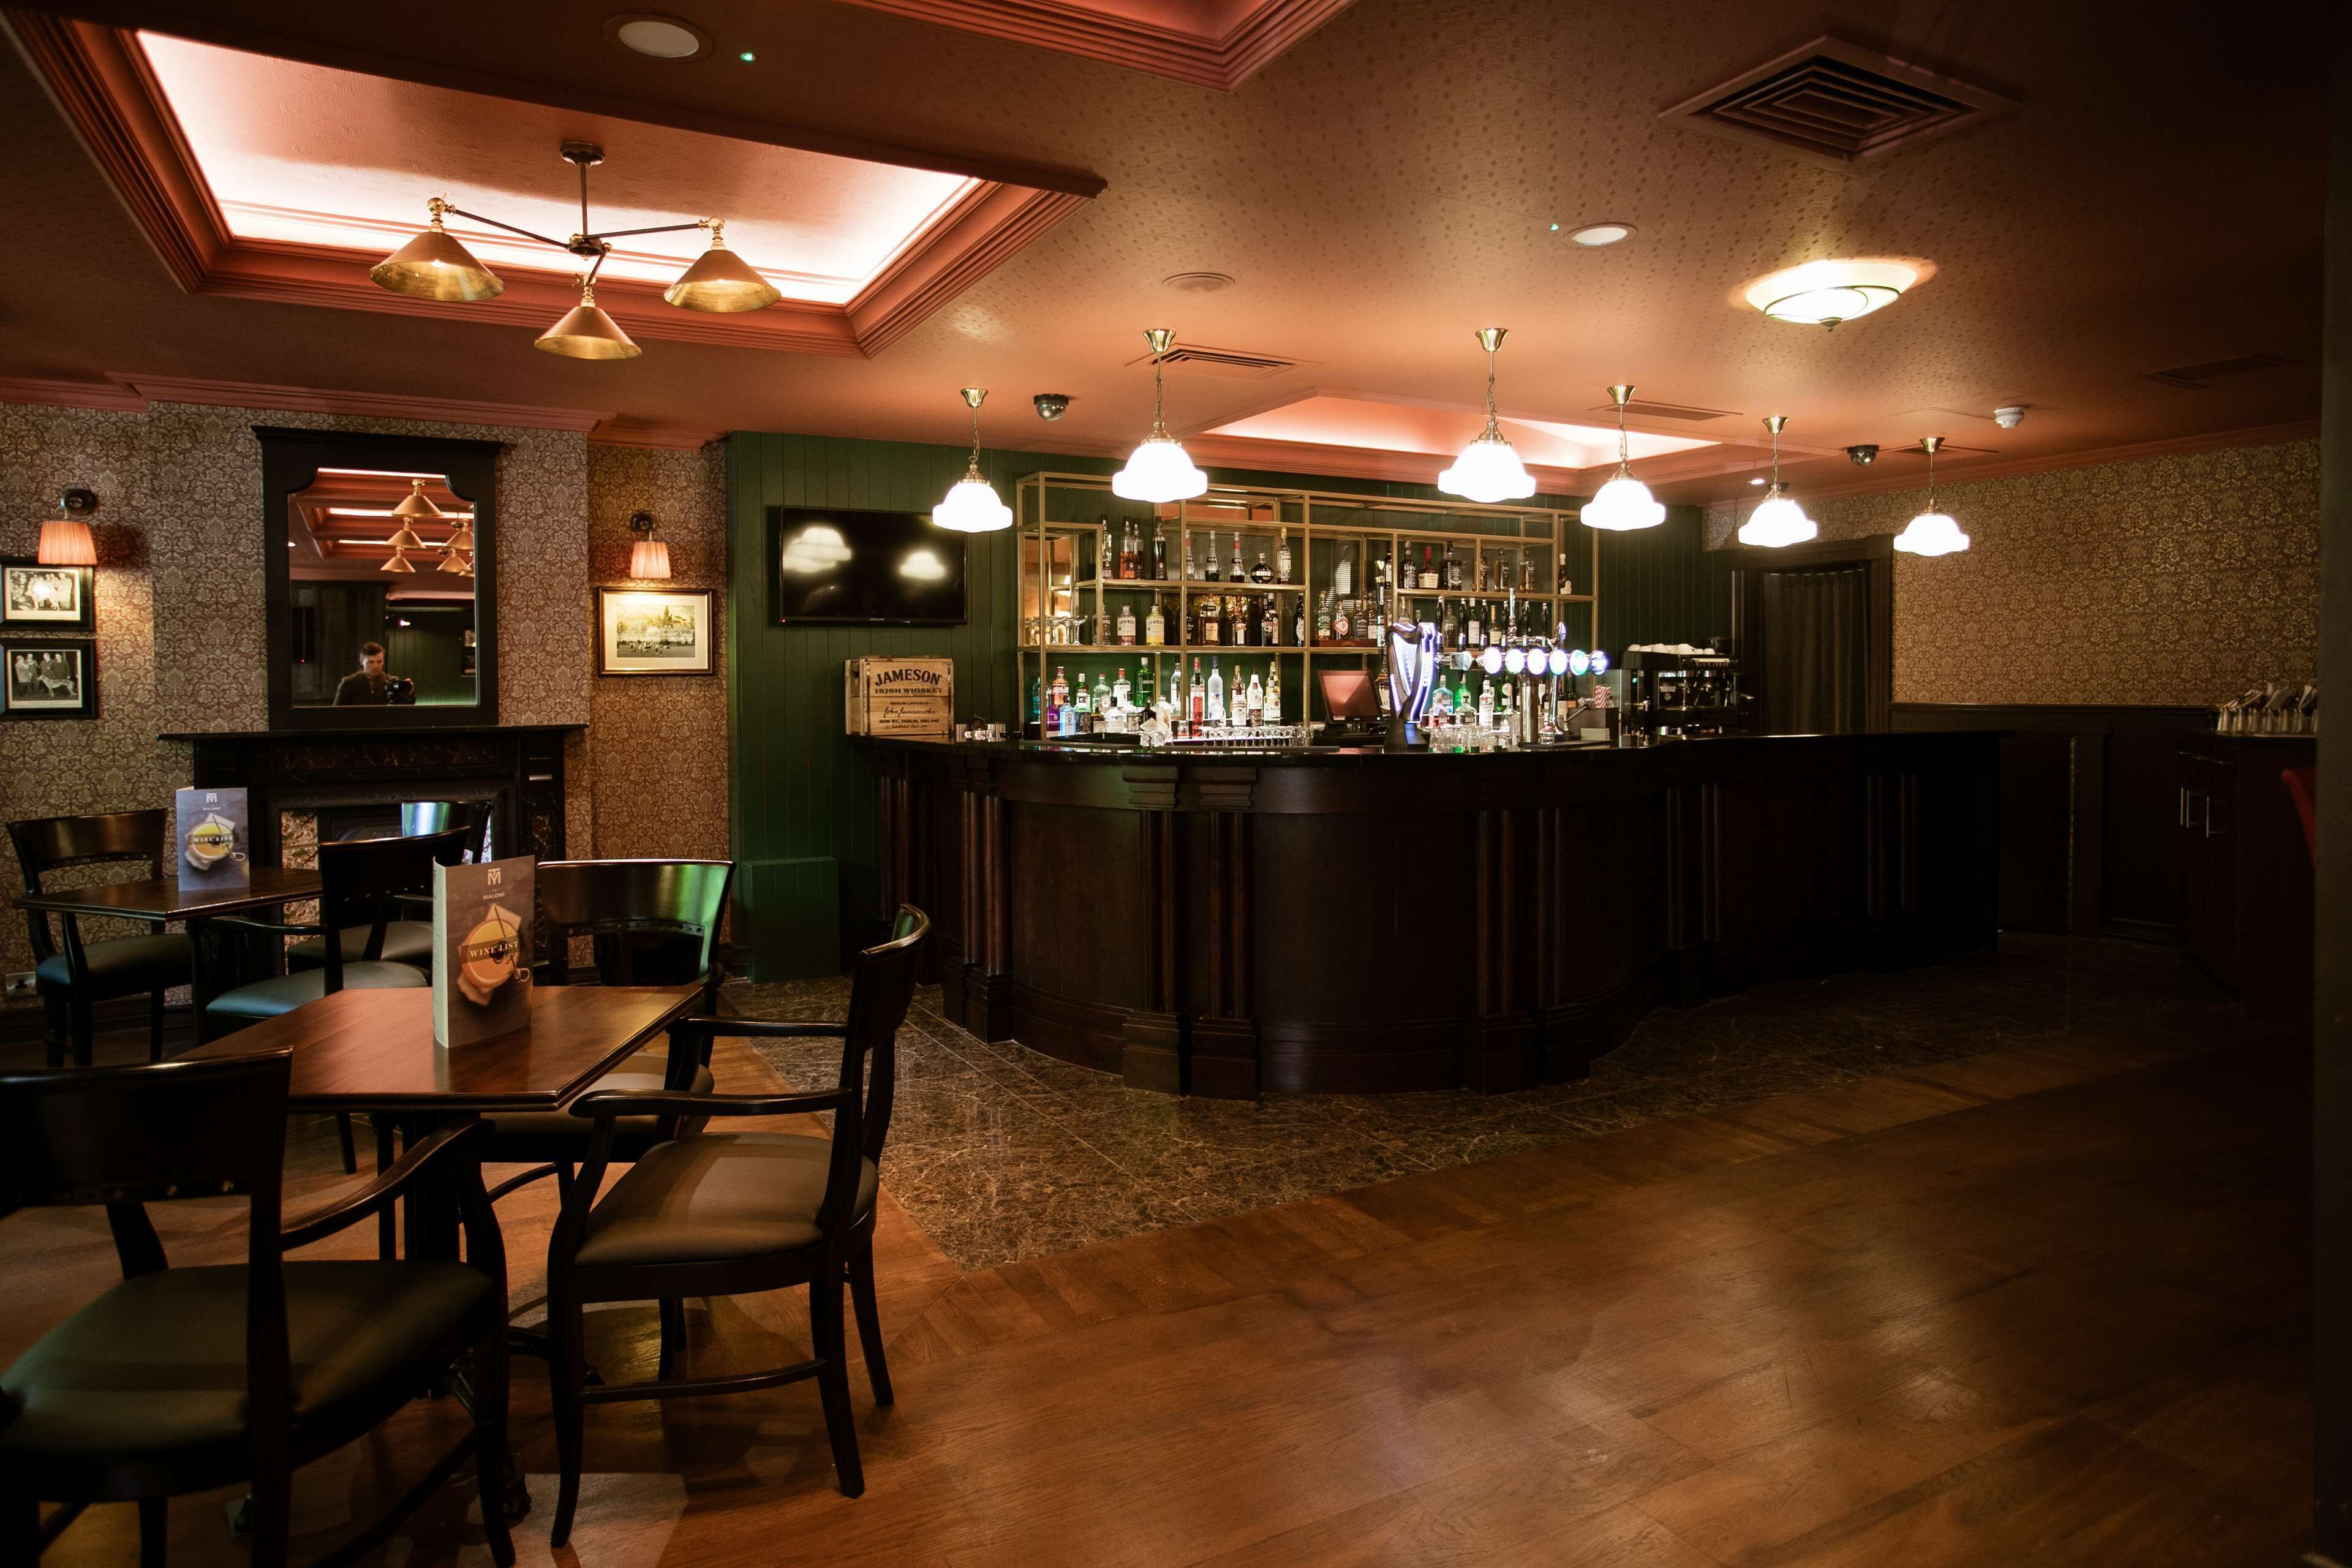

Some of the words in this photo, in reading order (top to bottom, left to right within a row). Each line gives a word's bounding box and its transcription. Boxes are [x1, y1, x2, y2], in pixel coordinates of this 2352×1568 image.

[875, 669, 942, 686] JAMESON
[483, 892, 505, 900] MALONE
[470, 946, 496, 957] WINE
[499, 941, 519, 952] LIST
